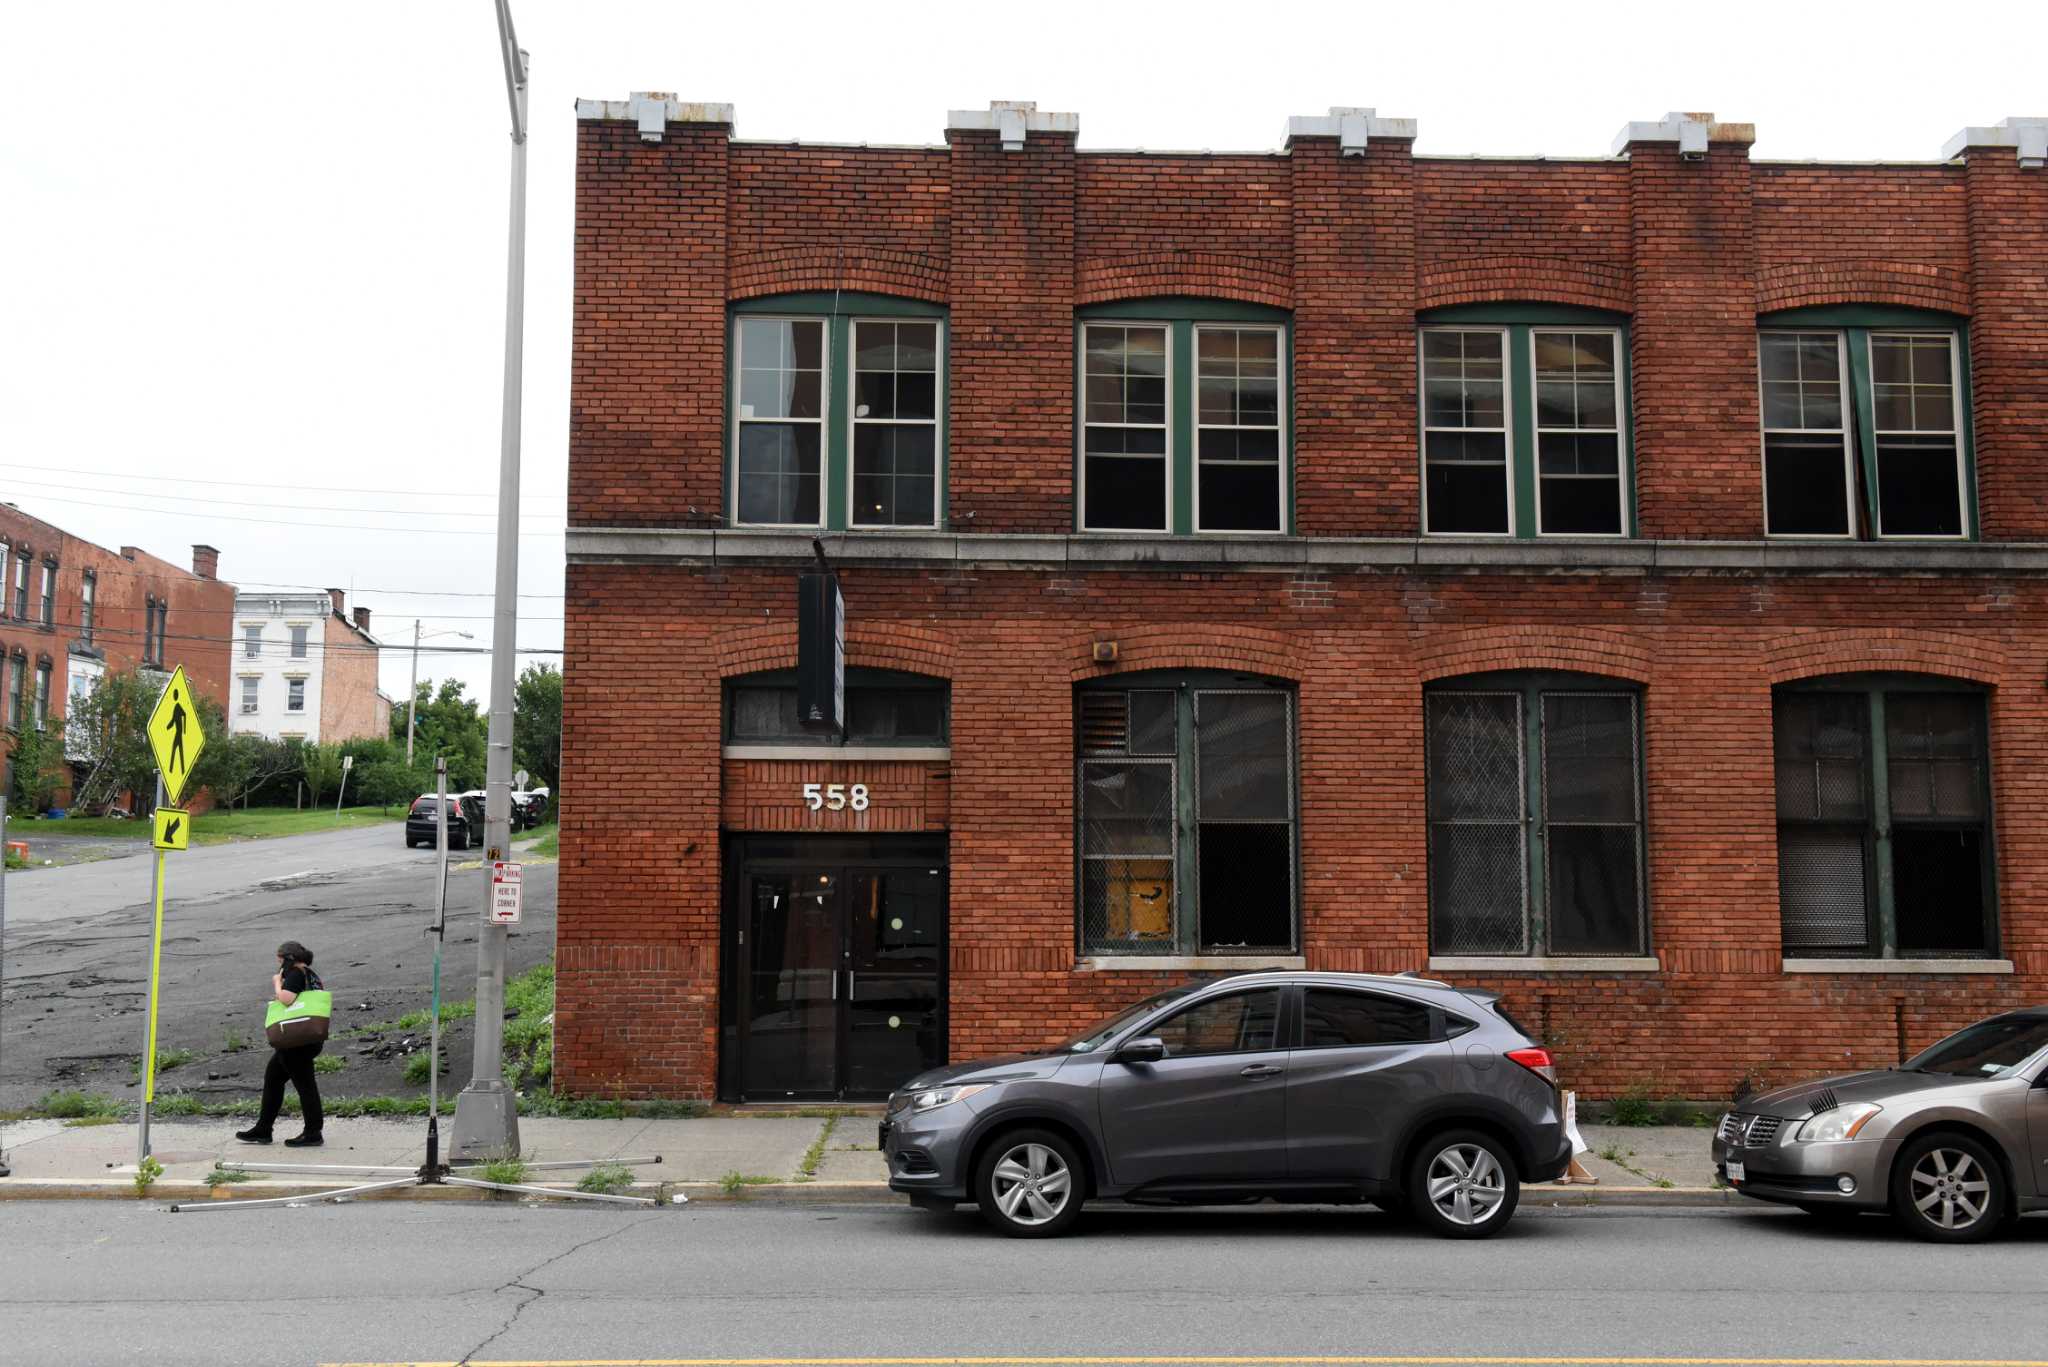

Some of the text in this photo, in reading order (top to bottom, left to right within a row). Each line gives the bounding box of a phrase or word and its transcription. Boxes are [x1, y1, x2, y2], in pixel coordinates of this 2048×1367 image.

[803, 783, 869, 811] 558
[503, 869, 521, 878] PARKING
[498, 887, 517, 896] HERE TO
[497, 899, 516, 907] CORNER
